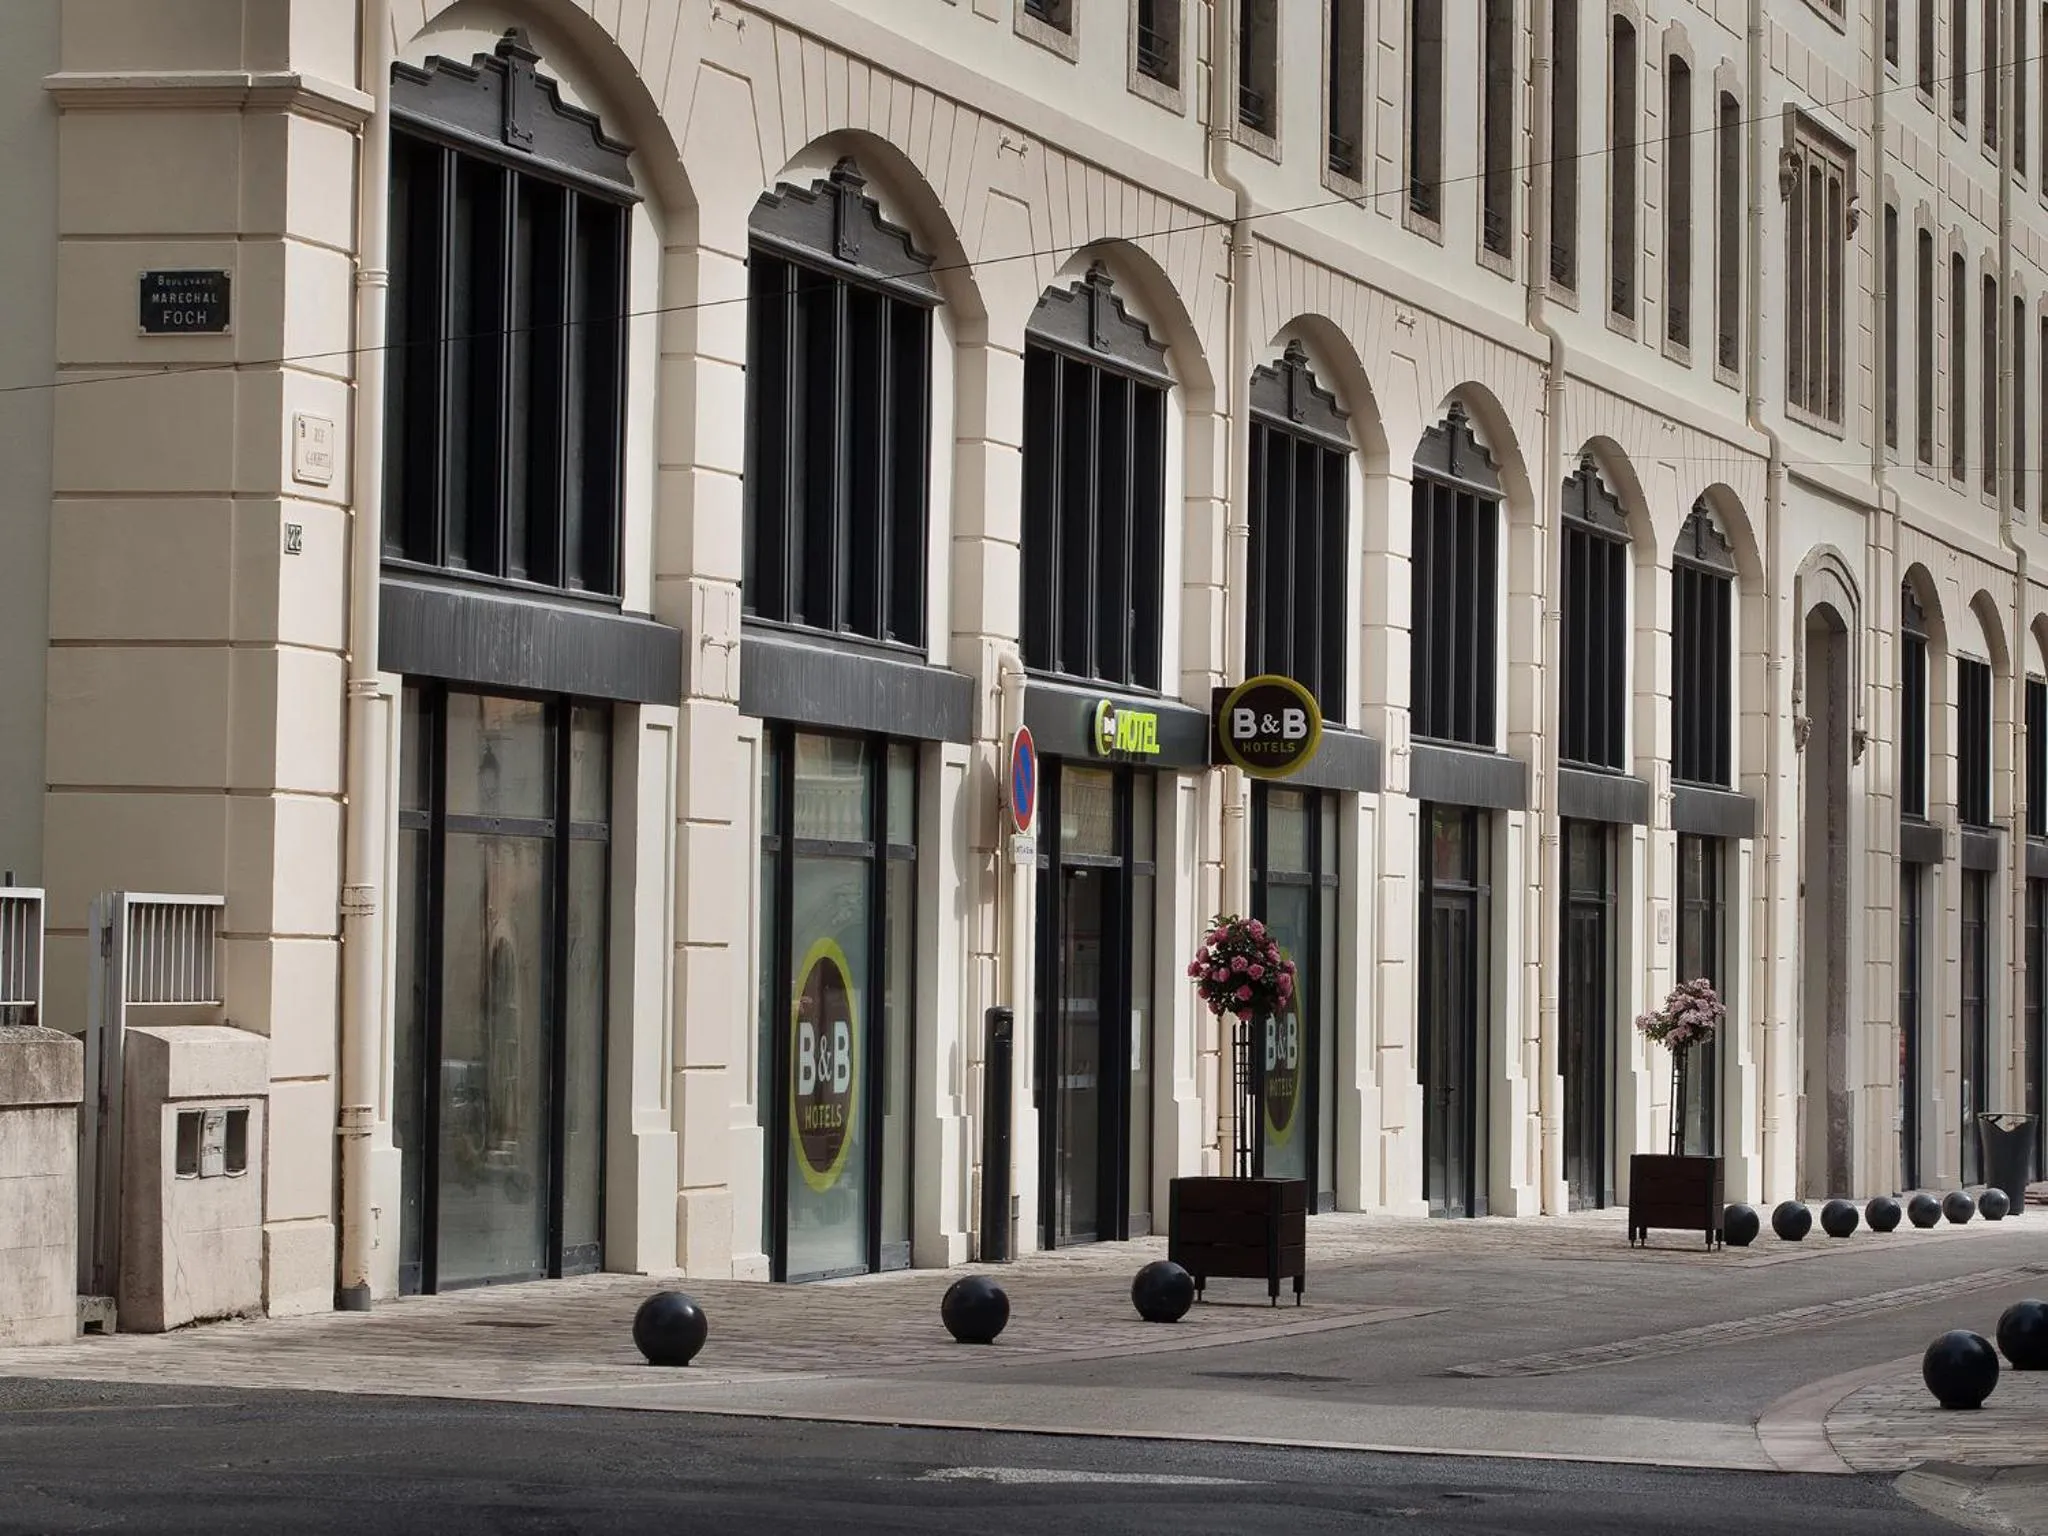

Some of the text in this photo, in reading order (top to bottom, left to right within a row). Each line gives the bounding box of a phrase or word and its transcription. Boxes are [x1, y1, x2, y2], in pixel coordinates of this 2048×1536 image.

[152, 293, 219, 303] MARECHAL
[163, 310, 207, 325] FOCH
[1115, 709, 1160, 754] HOTEL
[1233, 707, 1307, 739] B&B
[1243, 741, 1296, 753] HOTELS
[1265, 1011, 1298, 1071] B&B
[798, 1020, 850, 1096] B&B
[1269, 1078, 1293, 1097] HOTELS
[804, 1103, 842, 1130] HOTELS
